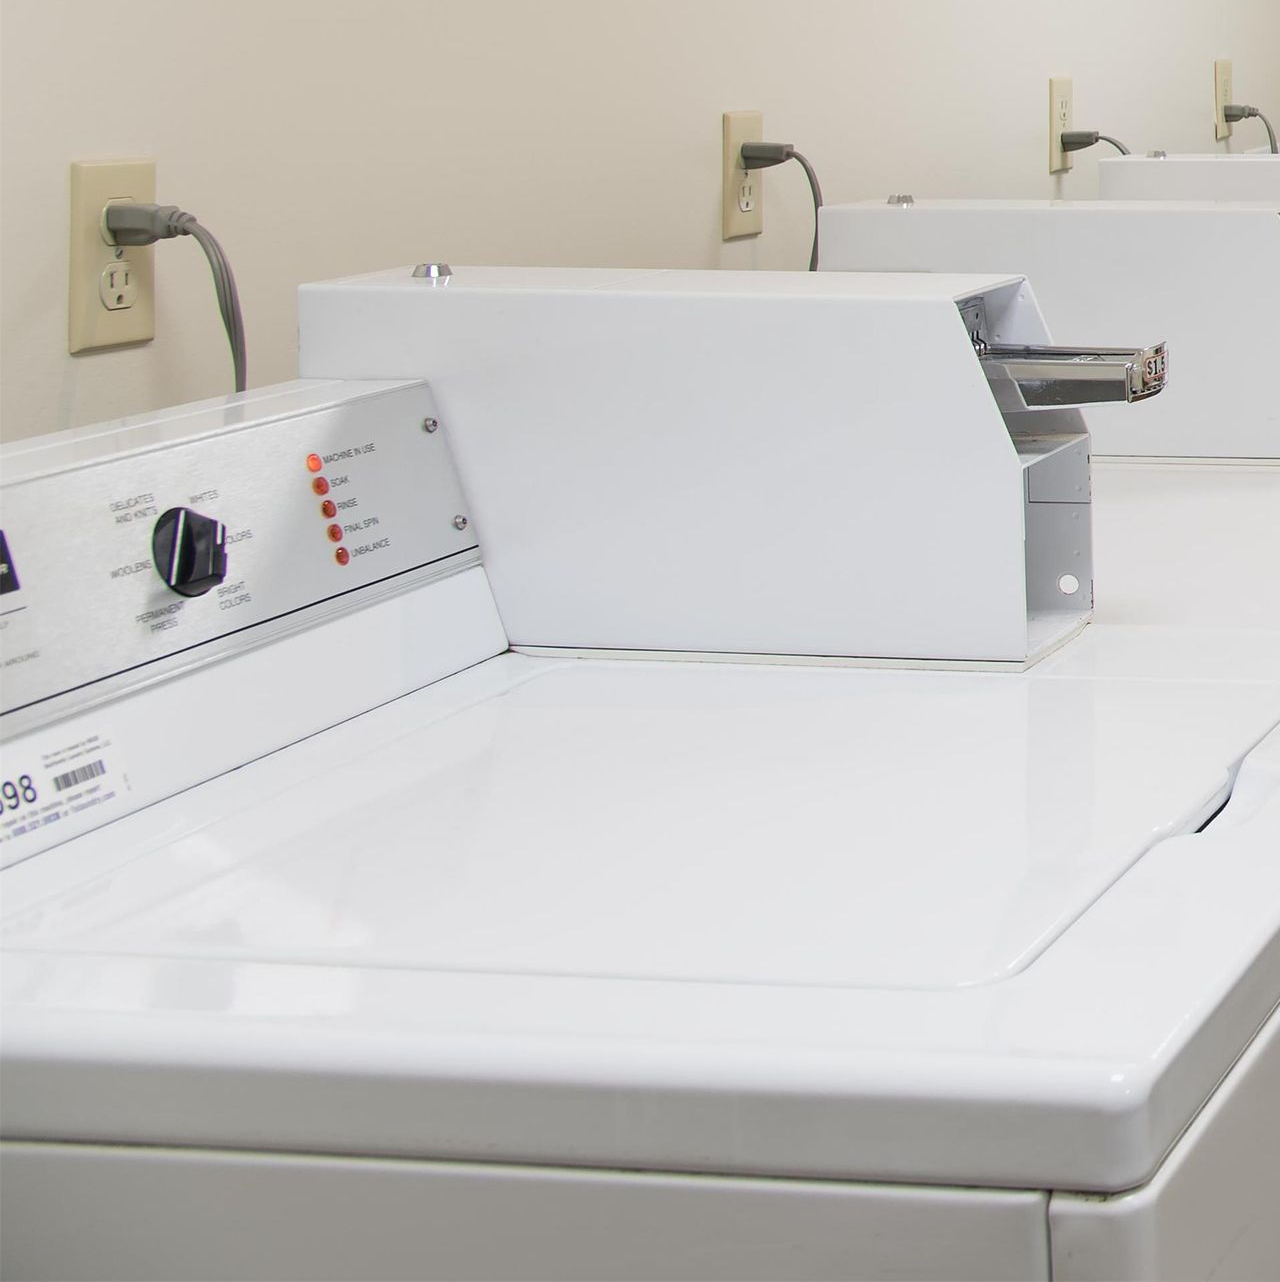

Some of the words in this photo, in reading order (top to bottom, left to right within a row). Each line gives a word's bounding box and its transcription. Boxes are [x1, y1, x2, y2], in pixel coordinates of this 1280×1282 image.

[322, 448, 354, 464] MACHINE
[354, 446, 361, 456] IN
[362, 443, 376, 454] USE
[330, 476, 350, 488] SOAK
[109, 493, 155, 512] DELICATES
[189, 489, 219, 504] WHITES
[337, 497, 358, 510] RINSE
[115, 512, 133, 524] AND
[134, 505, 158, 519] KNITS
[343, 523, 364, 534] FINAL
[363, 516, 380, 529] SPIN
[225, 529, 253, 545] OLORS
[351, 537, 391, 558] UNBALANCE
[110, 559, 153, 579] WOOLENS
[217, 581, 245, 597] BRIGHT
[219, 593, 252, 611] COLORS
[136, 601, 185, 623] PERMANENT
[150, 617, 178, 633] PRESS
[0, 774, 37, 816] 98
